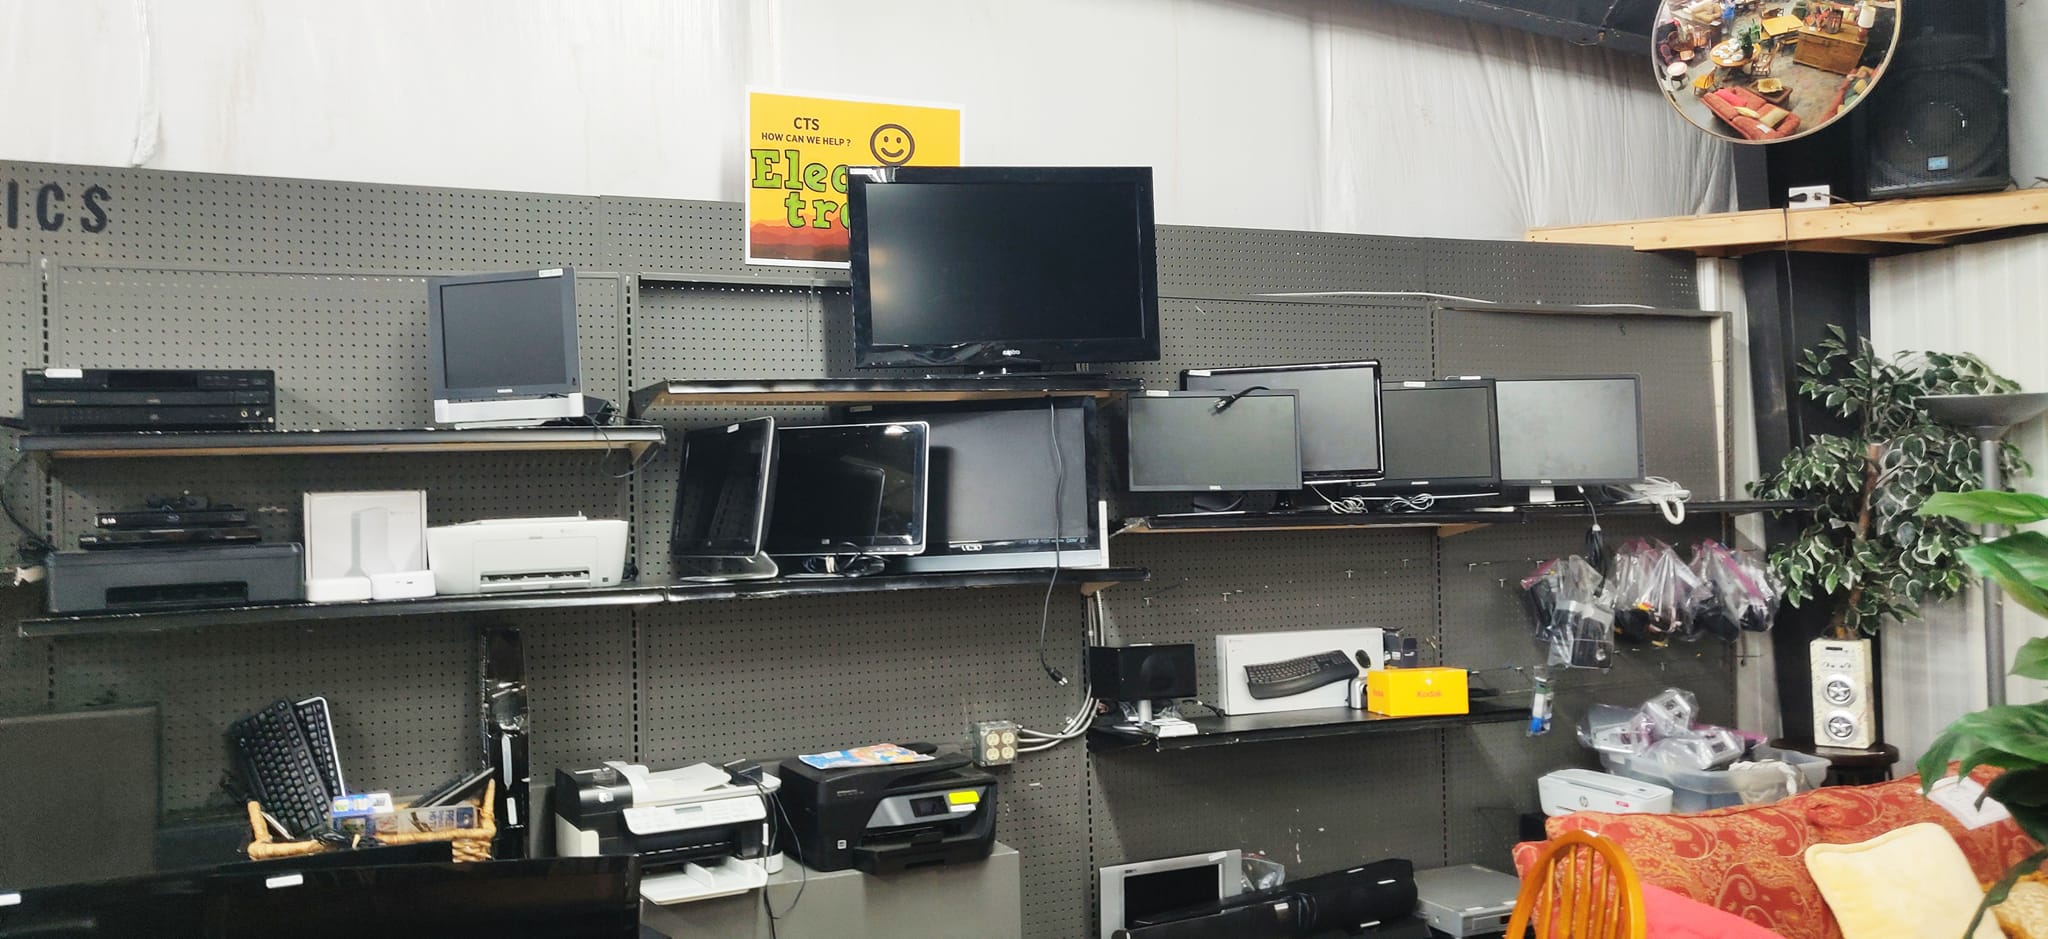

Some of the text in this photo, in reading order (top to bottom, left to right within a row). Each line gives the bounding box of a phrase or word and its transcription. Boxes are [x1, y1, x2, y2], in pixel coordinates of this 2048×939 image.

[794, 117, 819, 130] CTS
[761, 132, 784, 141] HOW
[785, 134, 804, 143] CAN
[806, 136, 820, 144] WE
[822, 138, 845, 146] HELP
[7, 181, 108, 233] ICS
